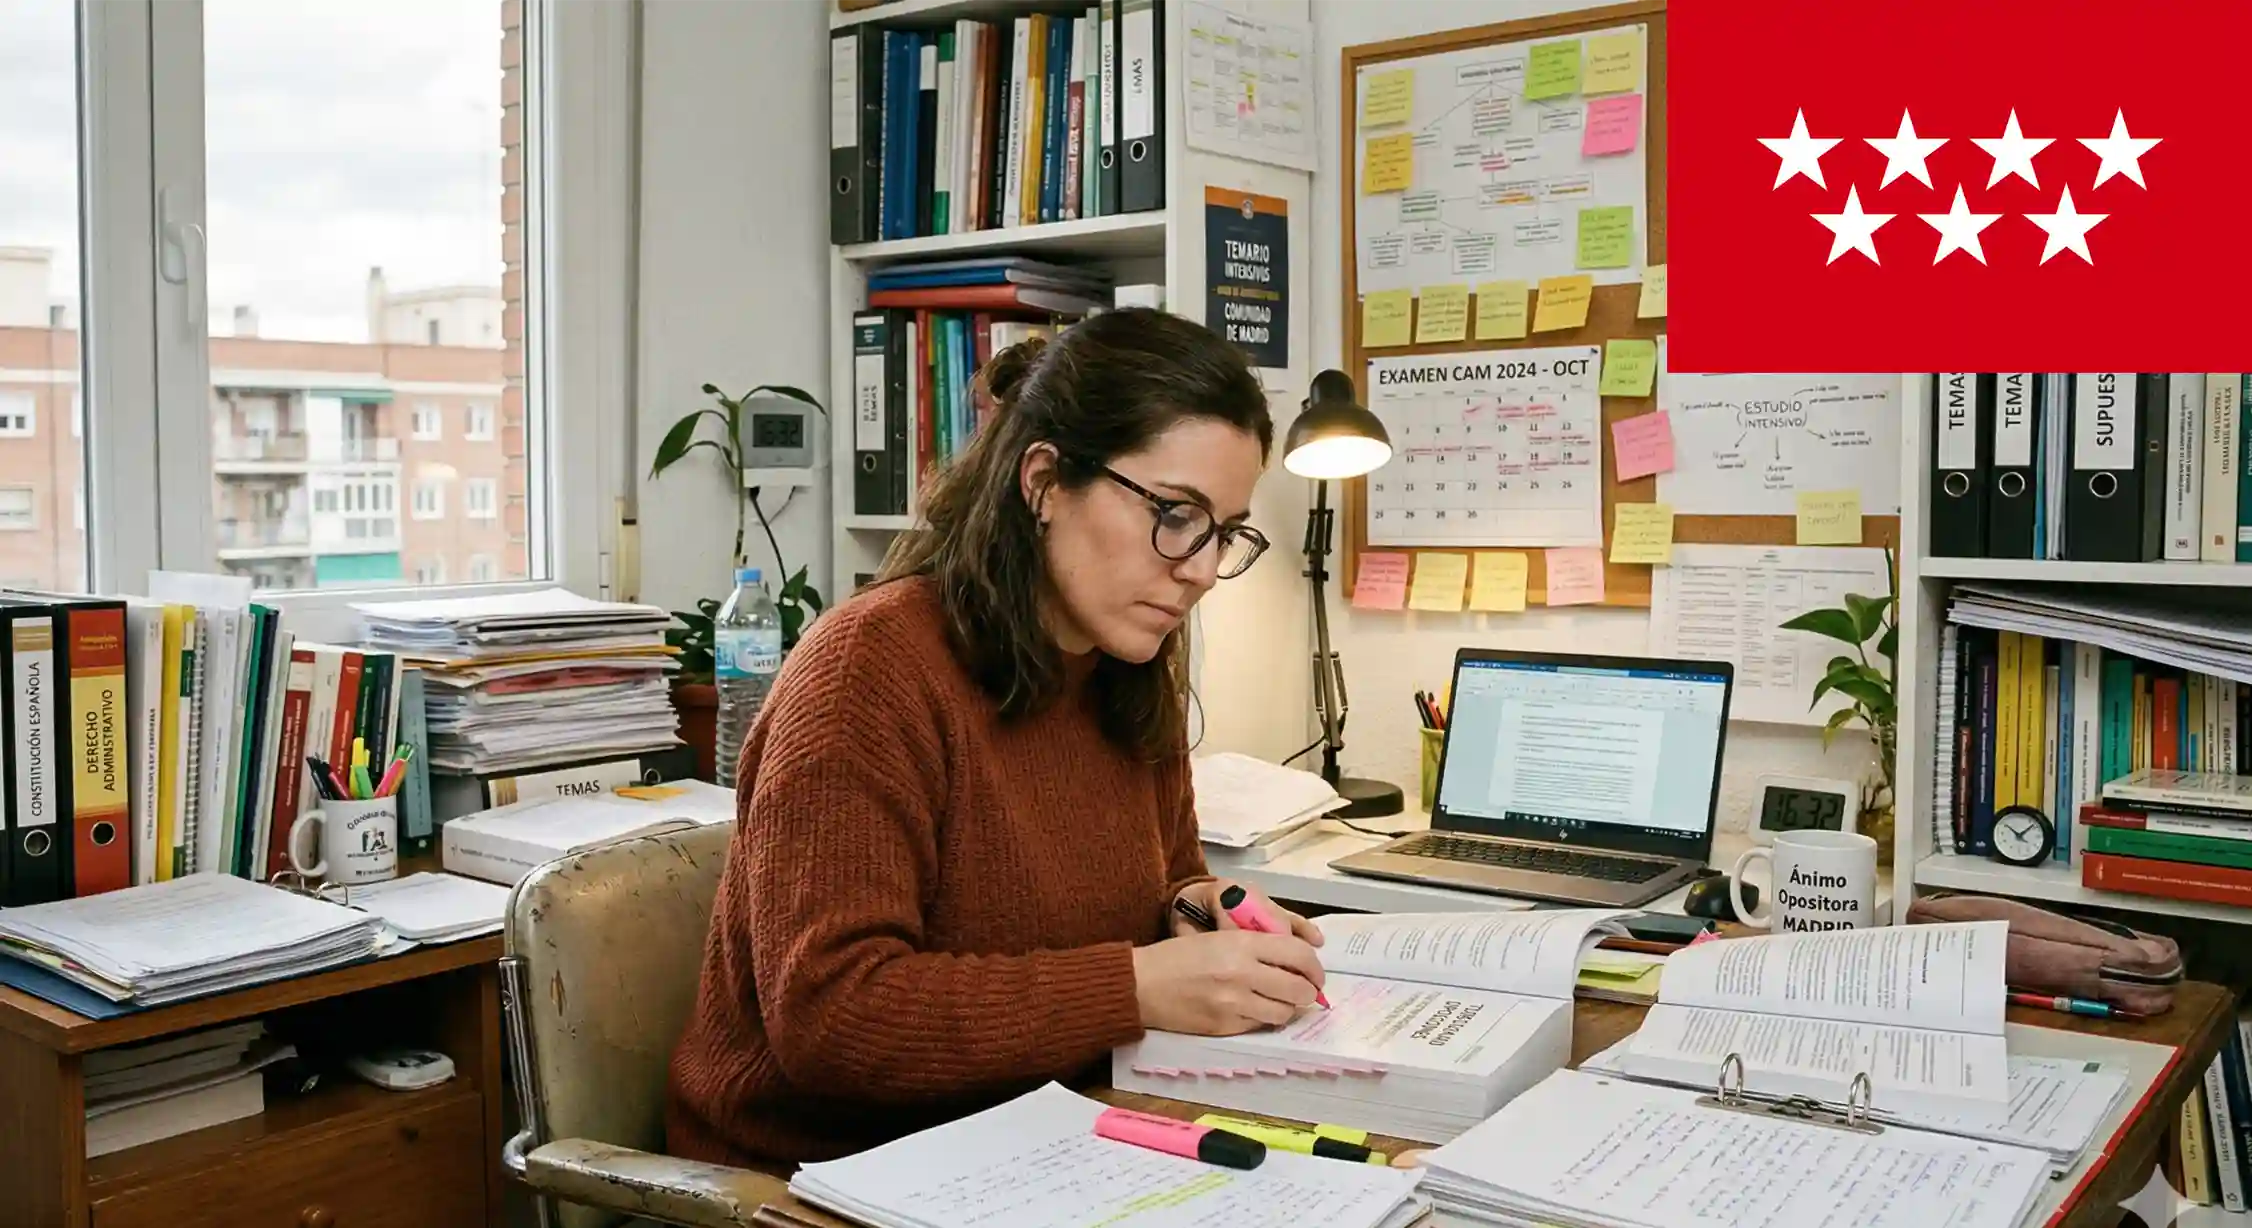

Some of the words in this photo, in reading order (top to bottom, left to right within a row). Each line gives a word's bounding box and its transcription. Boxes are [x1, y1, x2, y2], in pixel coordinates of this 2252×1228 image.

[1224, 239, 1270, 264] TEMARIO
[1226, 323, 1238, 342] DE
[1239, 324, 1270, 344] MADRID
[1379, 366, 1448, 385] EXAMEN
[1452, 364, 1492, 382] CAM
[1496, 361, 1537, 380] 2024
[1553, 359, 1590, 376] OCT
[1744, 400, 1803, 415] ESTUDIO
[26, 661, 41, 726] ESPAÑOLA
[86, 711, 99, 774] DERECHO
[101, 689, 115, 792] ADMINSTRATIVO
[556, 779, 601, 797] TEMAS
[1789, 863, 1847, 888] Ánimo
[1778, 888, 1859, 912] Opositora
